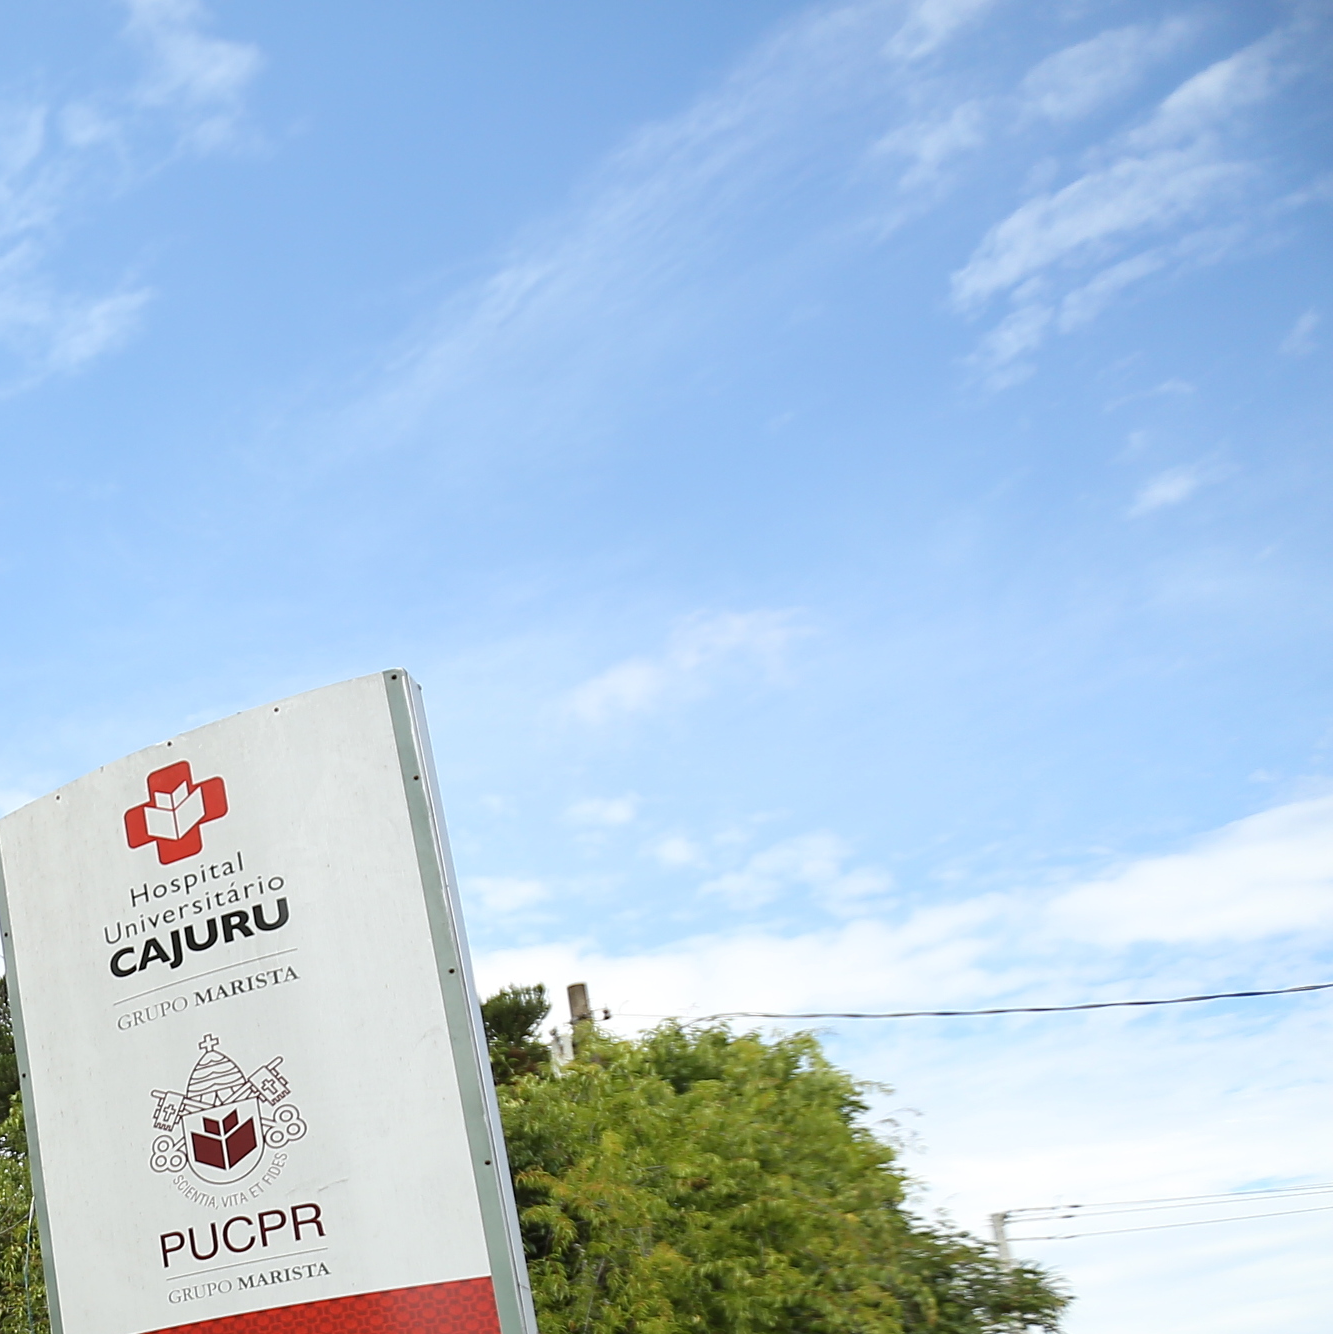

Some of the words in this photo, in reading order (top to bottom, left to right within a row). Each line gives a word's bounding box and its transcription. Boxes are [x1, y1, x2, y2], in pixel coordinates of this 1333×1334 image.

[104, 876, 284, 944] Universitário
[130, 851, 244, 907] Hospital
[109, 897, 290, 978] CAJURU
[117, 996, 188, 1031] GRUPO
[194, 965, 300, 1007] MARISTA
[173, 1174, 219, 1210] SCIENTIA,
[221, 1191, 249, 1209] VITA
[249, 1182, 264, 1198] ET
[261, 1152, 288, 1185] FIDES
[160, 1203, 326, 1268] PUCPR
[168, 1280, 232, 1304] GRUPO
[237, 1262, 331, 1290] MARISTA
